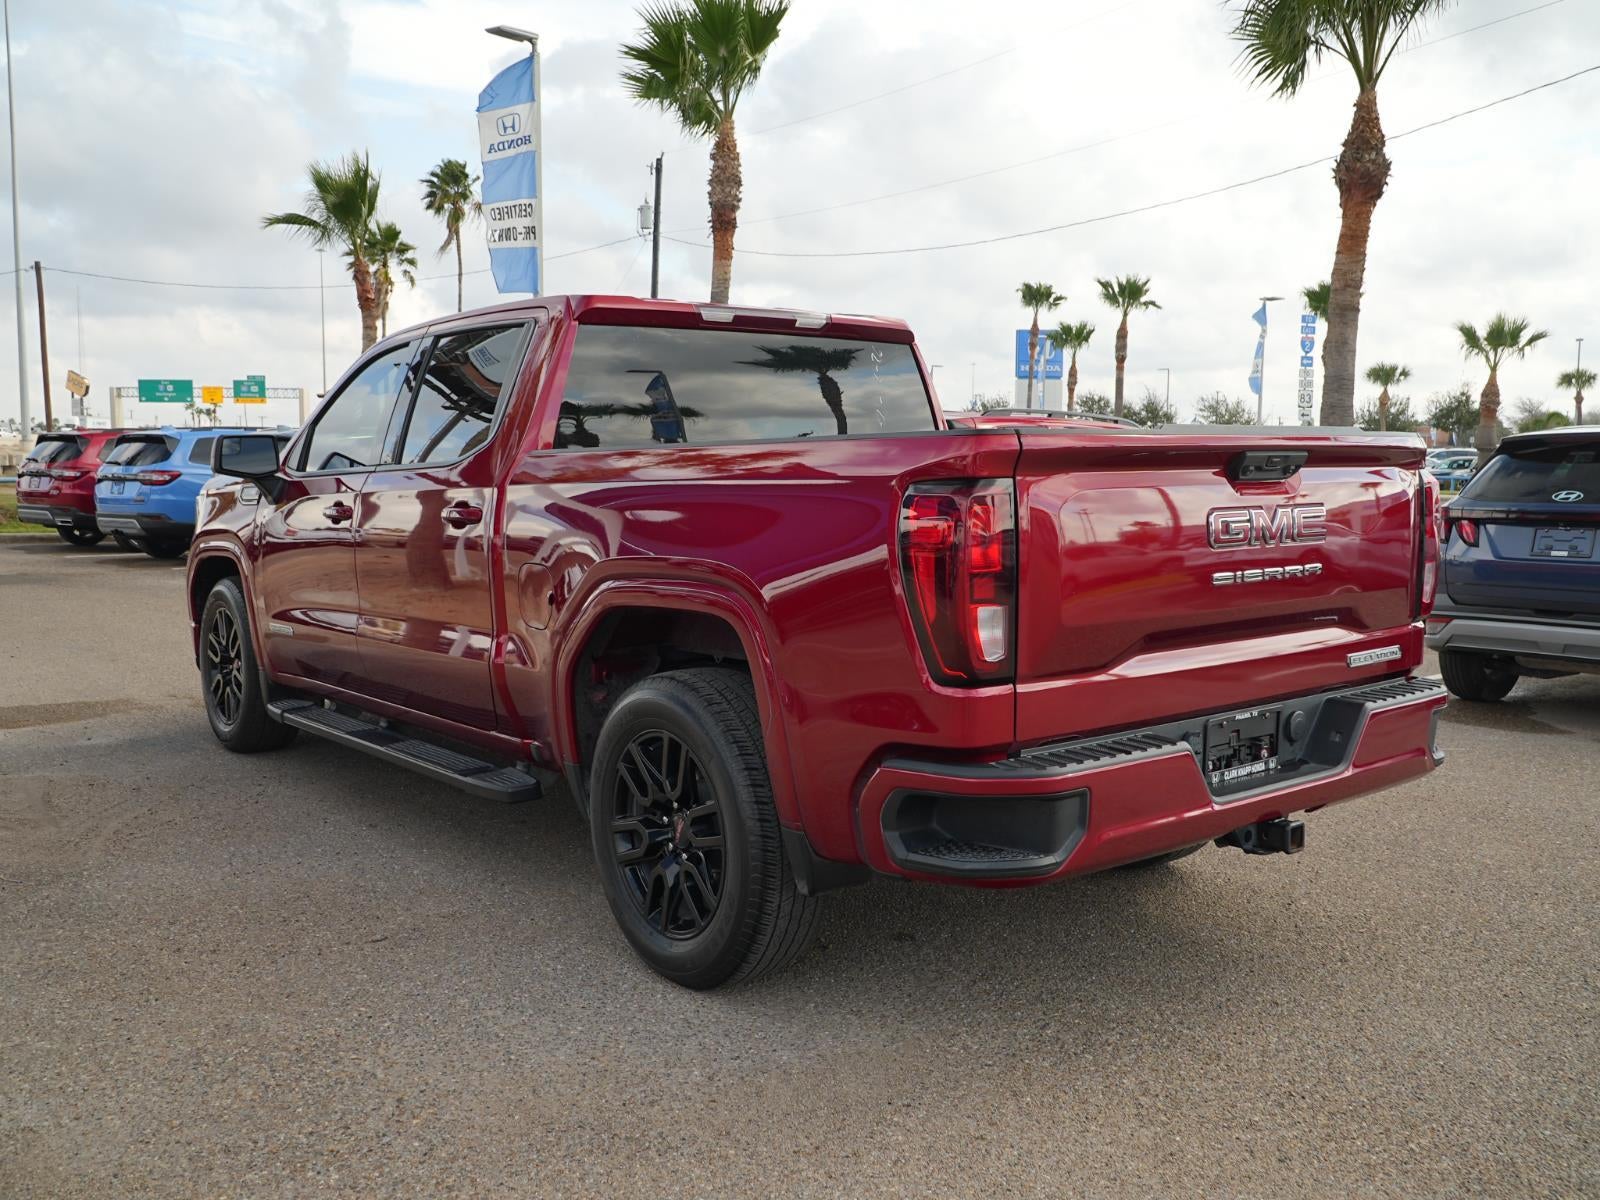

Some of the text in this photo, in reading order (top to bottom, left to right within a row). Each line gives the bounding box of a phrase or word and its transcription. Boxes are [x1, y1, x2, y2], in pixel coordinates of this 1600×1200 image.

[1304, 341, 1311, 350] 2
[1300, 393, 1311, 404] 83
[1207, 503, 1327, 551] GMC
[1212, 562, 1322, 585] SIERRA
[1352, 649, 1398, 664] ELEVATION
[1224, 770, 1237, 780] CLARK
[1251, 762, 1265, 773] HONDA
